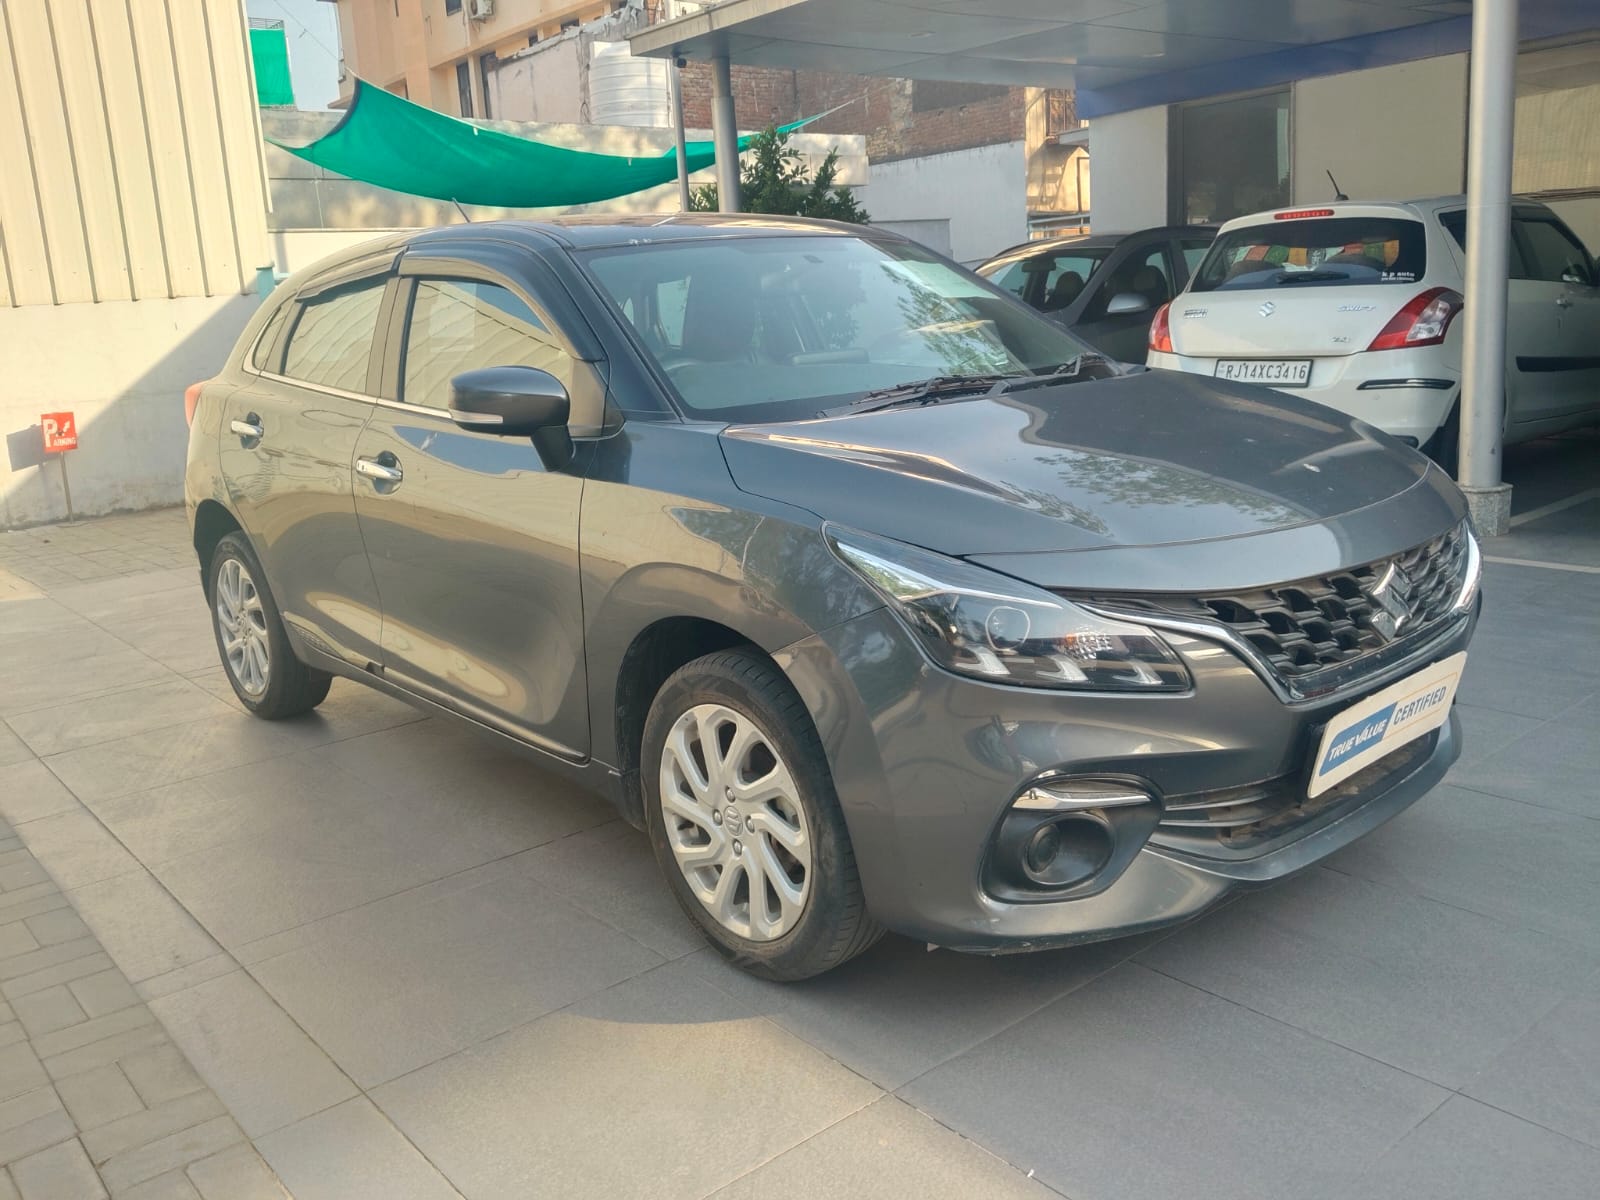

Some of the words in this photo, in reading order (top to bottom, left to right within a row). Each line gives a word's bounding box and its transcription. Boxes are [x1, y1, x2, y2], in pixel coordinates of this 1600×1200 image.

[1225, 362, 1307, 379] RJ14XC3416
[1328, 736, 1356, 762] TRUE
[1354, 718, 1388, 746] VALUE
[1393, 686, 1447, 726] CERTIFIED
